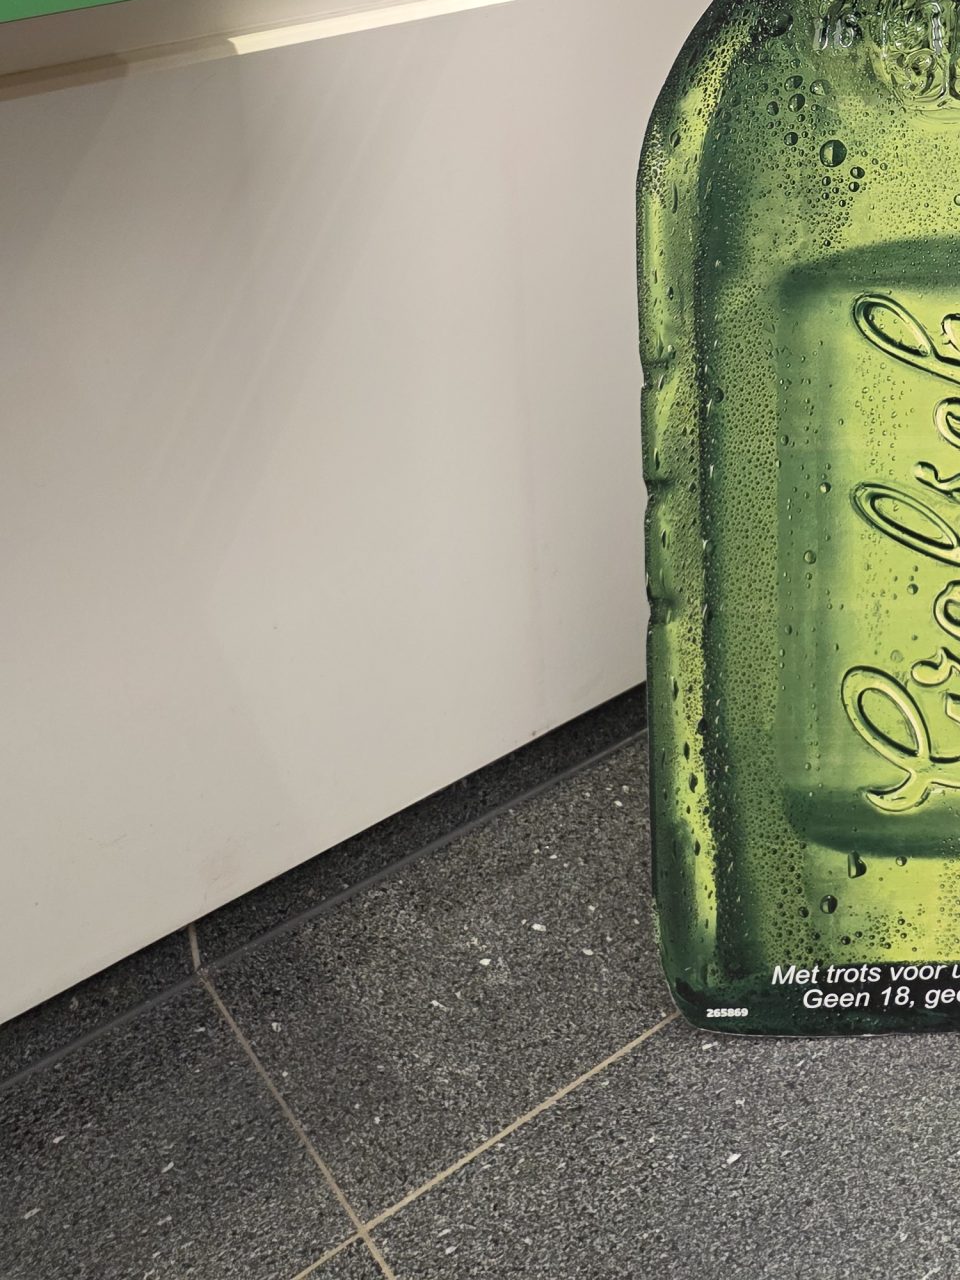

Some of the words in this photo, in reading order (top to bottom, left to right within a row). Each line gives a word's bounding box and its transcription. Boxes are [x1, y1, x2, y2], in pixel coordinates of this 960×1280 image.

[771, 964, 820, 985] Met
[826, 963, 882, 984] trots
[890, 963, 947, 982] voor
[803, 988, 870, 1009] Geen
[880, 985, 915, 1008] 18,
[706, 1008, 749, 1018] 265869
